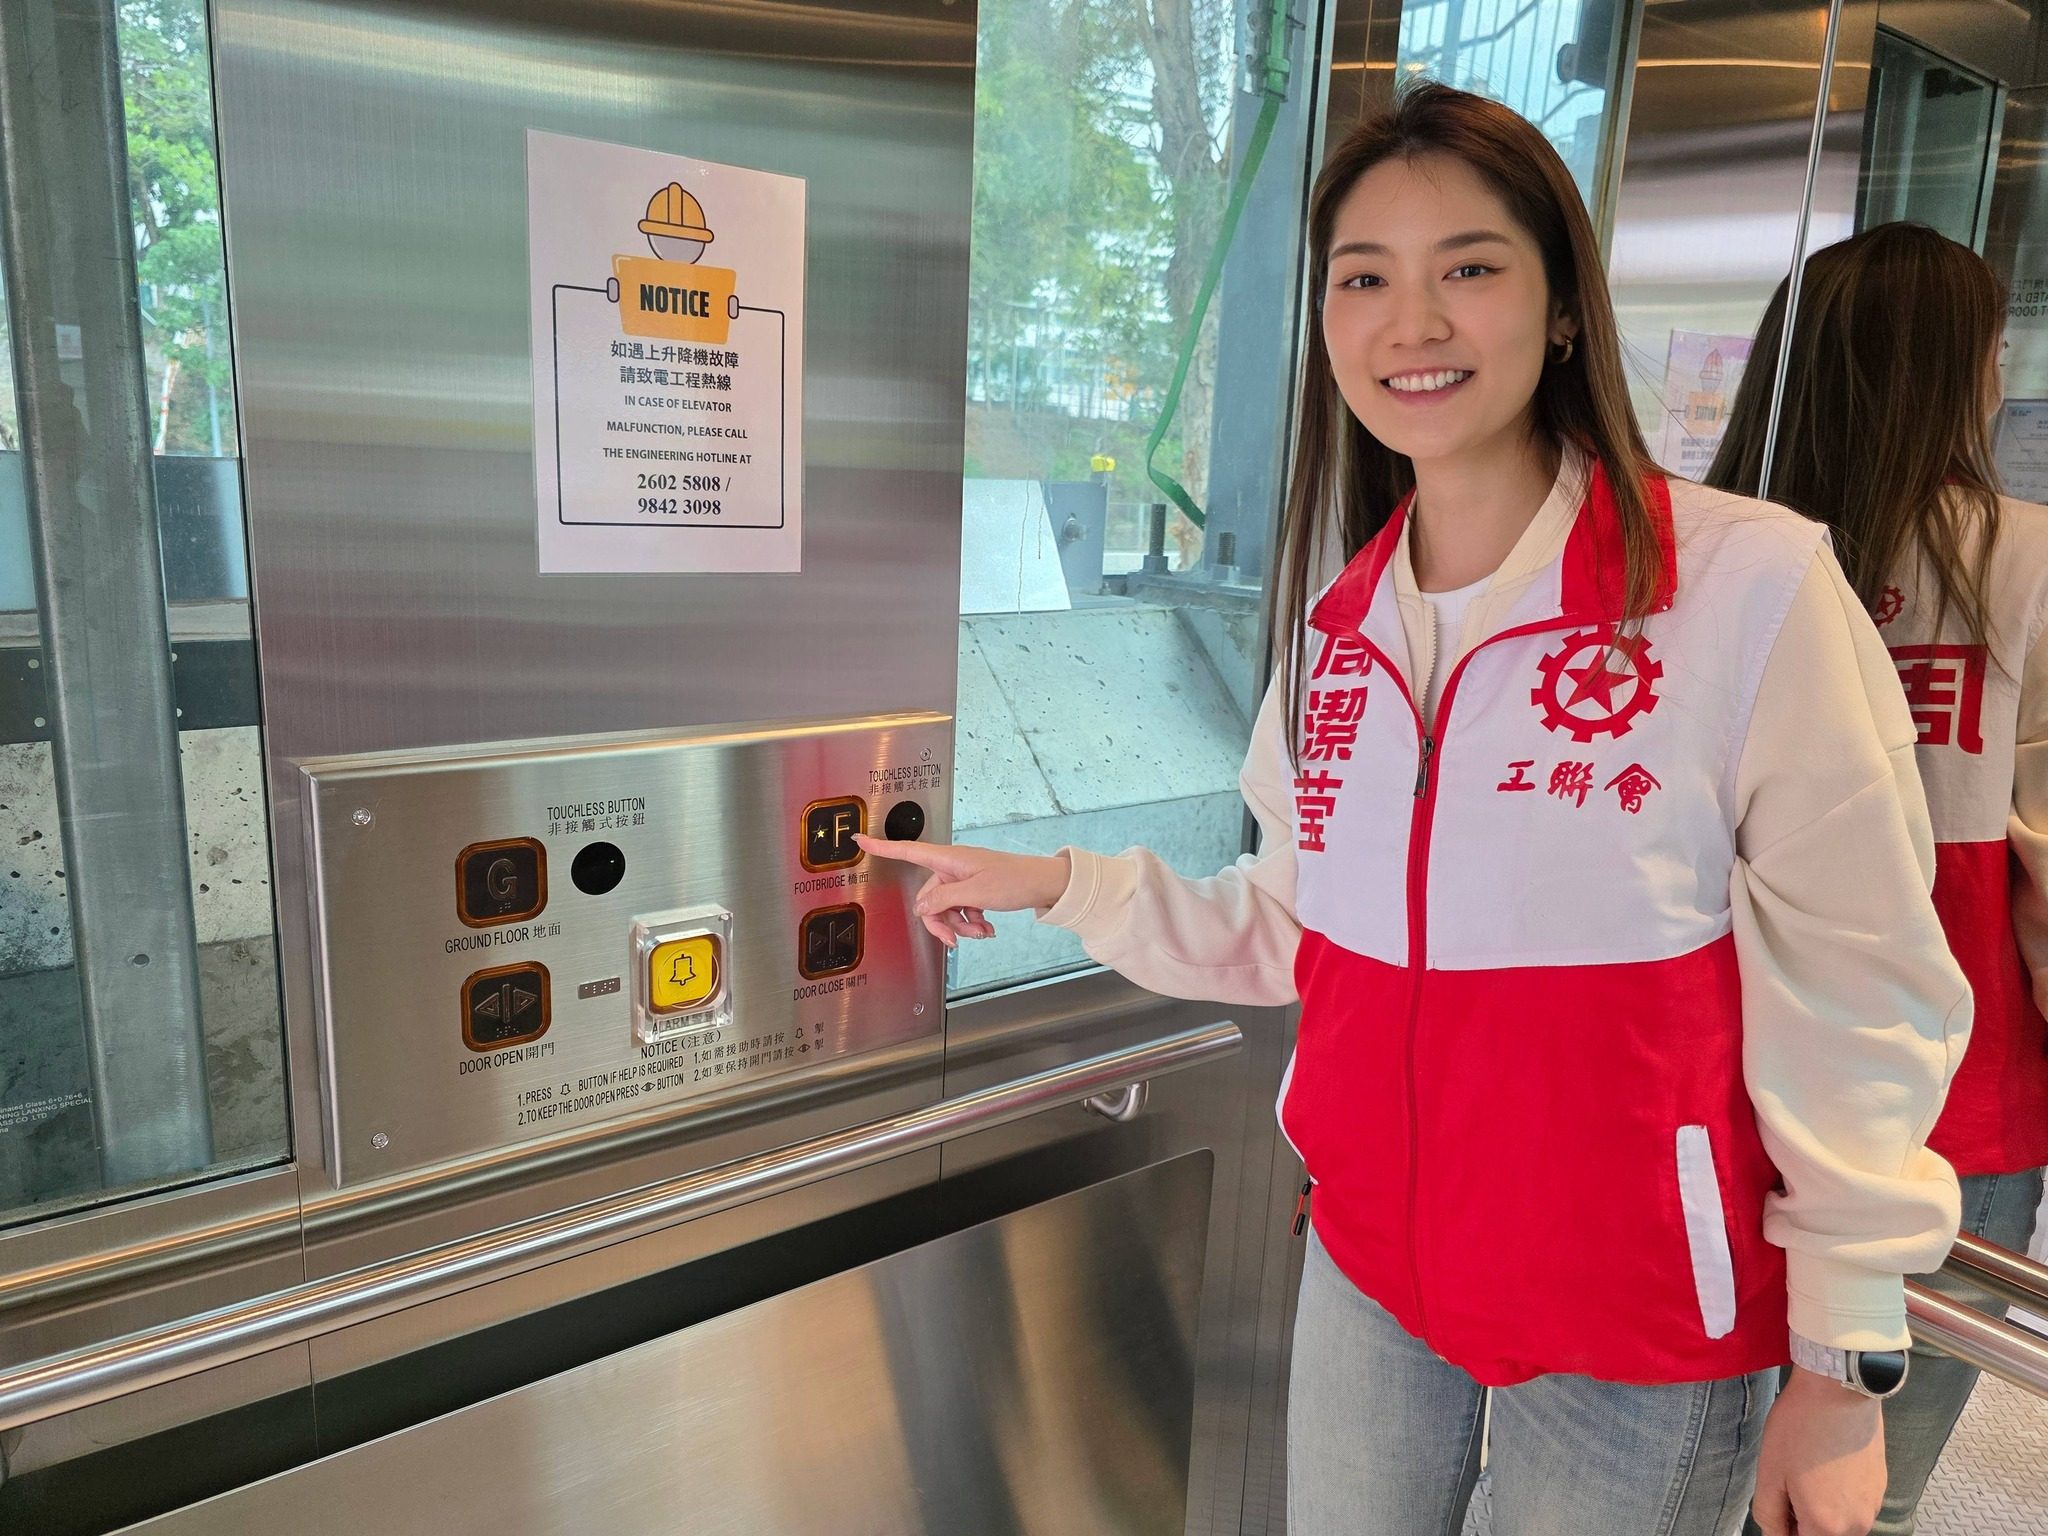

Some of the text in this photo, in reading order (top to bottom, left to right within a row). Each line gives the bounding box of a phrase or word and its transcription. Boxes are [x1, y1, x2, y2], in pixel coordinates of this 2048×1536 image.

[640, 284, 709, 318] NOTICE
[611, 340, 739, 368] 如遇上升降機故障
[620, 366, 731, 391] 請致電工程熱線
[625, 395, 732, 412] IN CASE OF ELEVATOR
[607, 421, 747, 439] MALFUNCTION, PLEASE CALL
[603, 448, 751, 464] THE ENGINEERING HOTLINE AT
[638, 474, 676, 490] 2602
[683, 476, 721, 491] 5808
[638, 498, 721, 515] 9842 3098
[869, 764, 941, 782] TOUCHLESS BUTTON
[1497, 760, 1662, 814] 工聯會
[547, 797, 645, 820] TOUCHLESS BUTTON
[548, 813, 645, 836] 非接觸式按鈕
[833, 811, 851, 848] F
[487, 858, 518, 900] G
[794, 875, 845, 894] FOOTBRIDGE
[445, 922, 560, 953] GROUND FLOOR 地面
[794, 985, 816, 1000] DOOR
[819, 979, 843, 995] CLOSE
[460, 1042, 554, 1075] DOOR OPEN 開門
[641, 1040, 677, 1059] NOTICE
[579, 1073, 608, 1092] BUTTON
[610, 1071, 617, 1084] IF
[619, 1066, 637, 1081] HELP
[639, 1064, 646, 1077] IS
[648, 1056, 684, 1075] REQUIRED
[21, 1104, 57, 1115] LANXING
[60, 1097, 92, 1108] SPECIAL
[538, 1104, 558, 1120] KEEP
[559, 1100, 573, 1115] THE
[574, 1095, 594, 1112] DOOR
[596, 1090, 615, 1106] OPEN
[617, 1084, 639, 1100] PRESS
[657, 1073, 684, 1091] BUTTON
